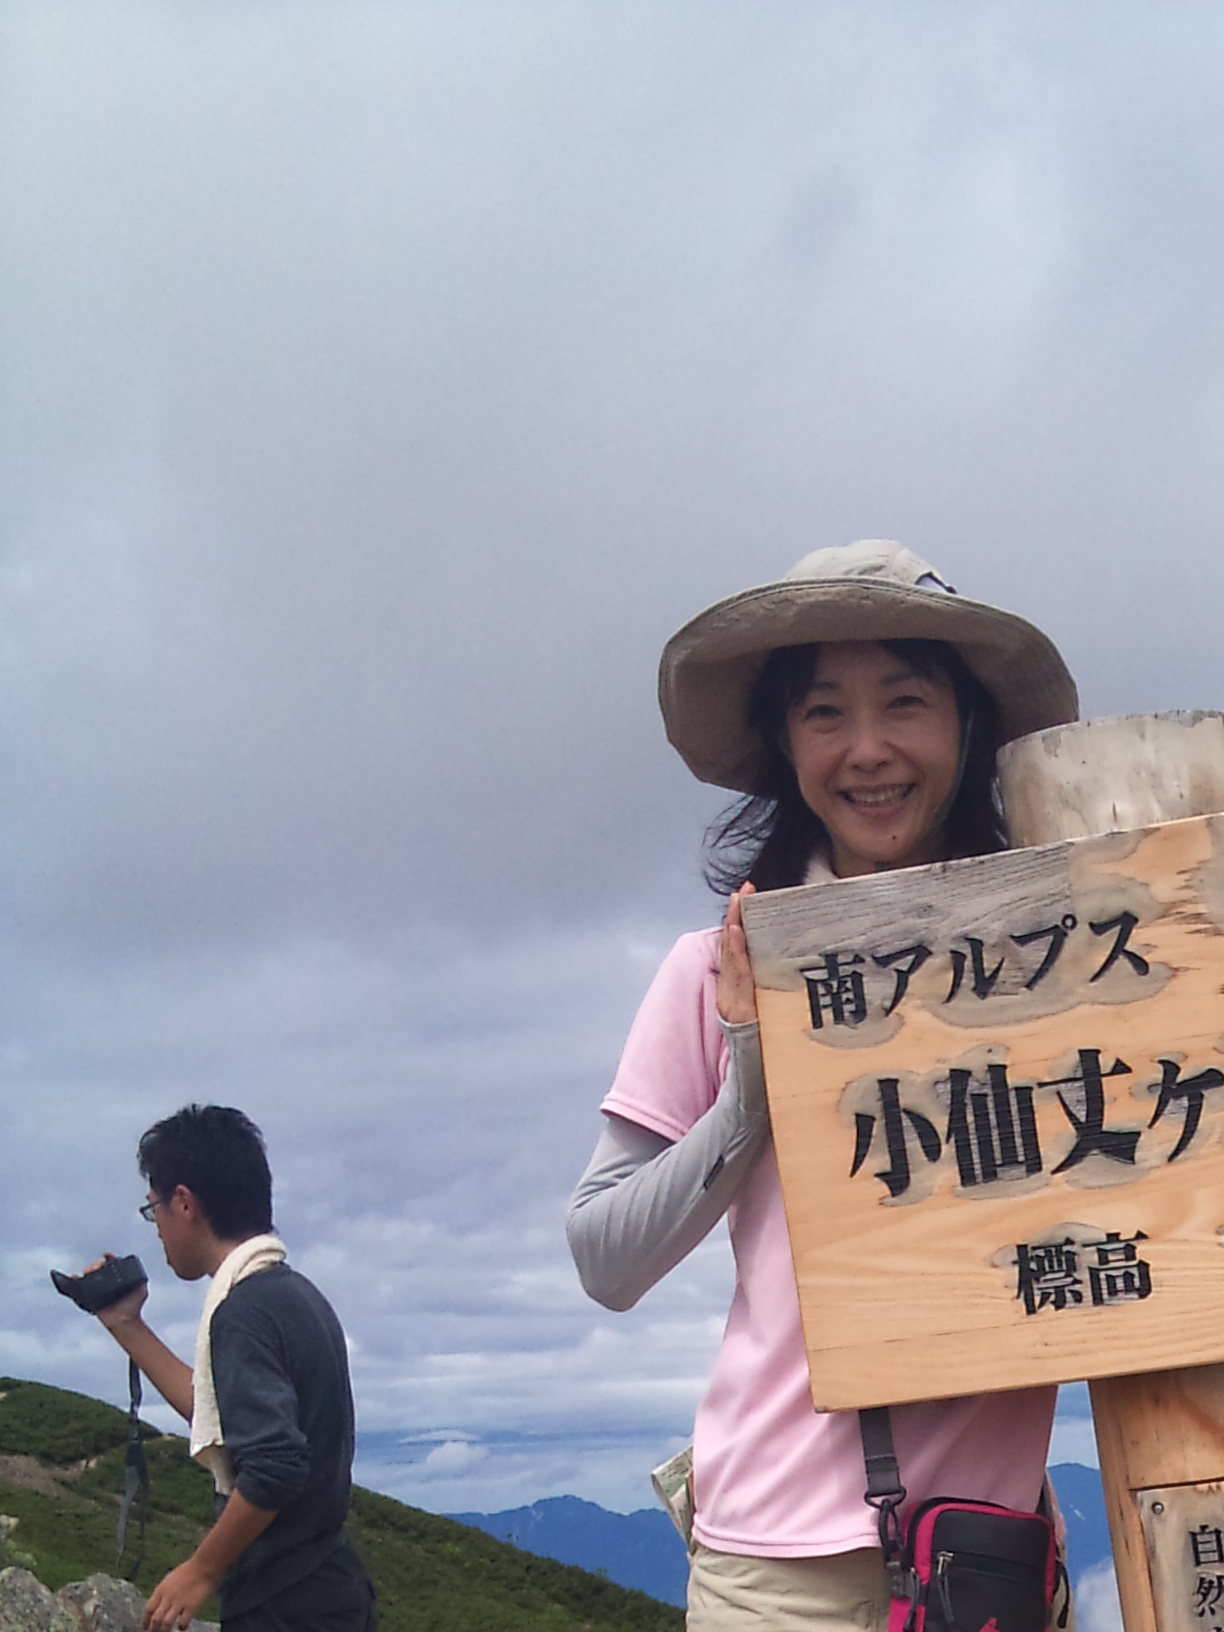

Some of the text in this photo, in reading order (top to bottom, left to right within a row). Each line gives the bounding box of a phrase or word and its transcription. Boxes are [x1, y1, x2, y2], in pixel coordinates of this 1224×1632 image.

[800, 911, 1150, 1029] 南アルプス
[1014, 1231, 1152, 1315] 標高
